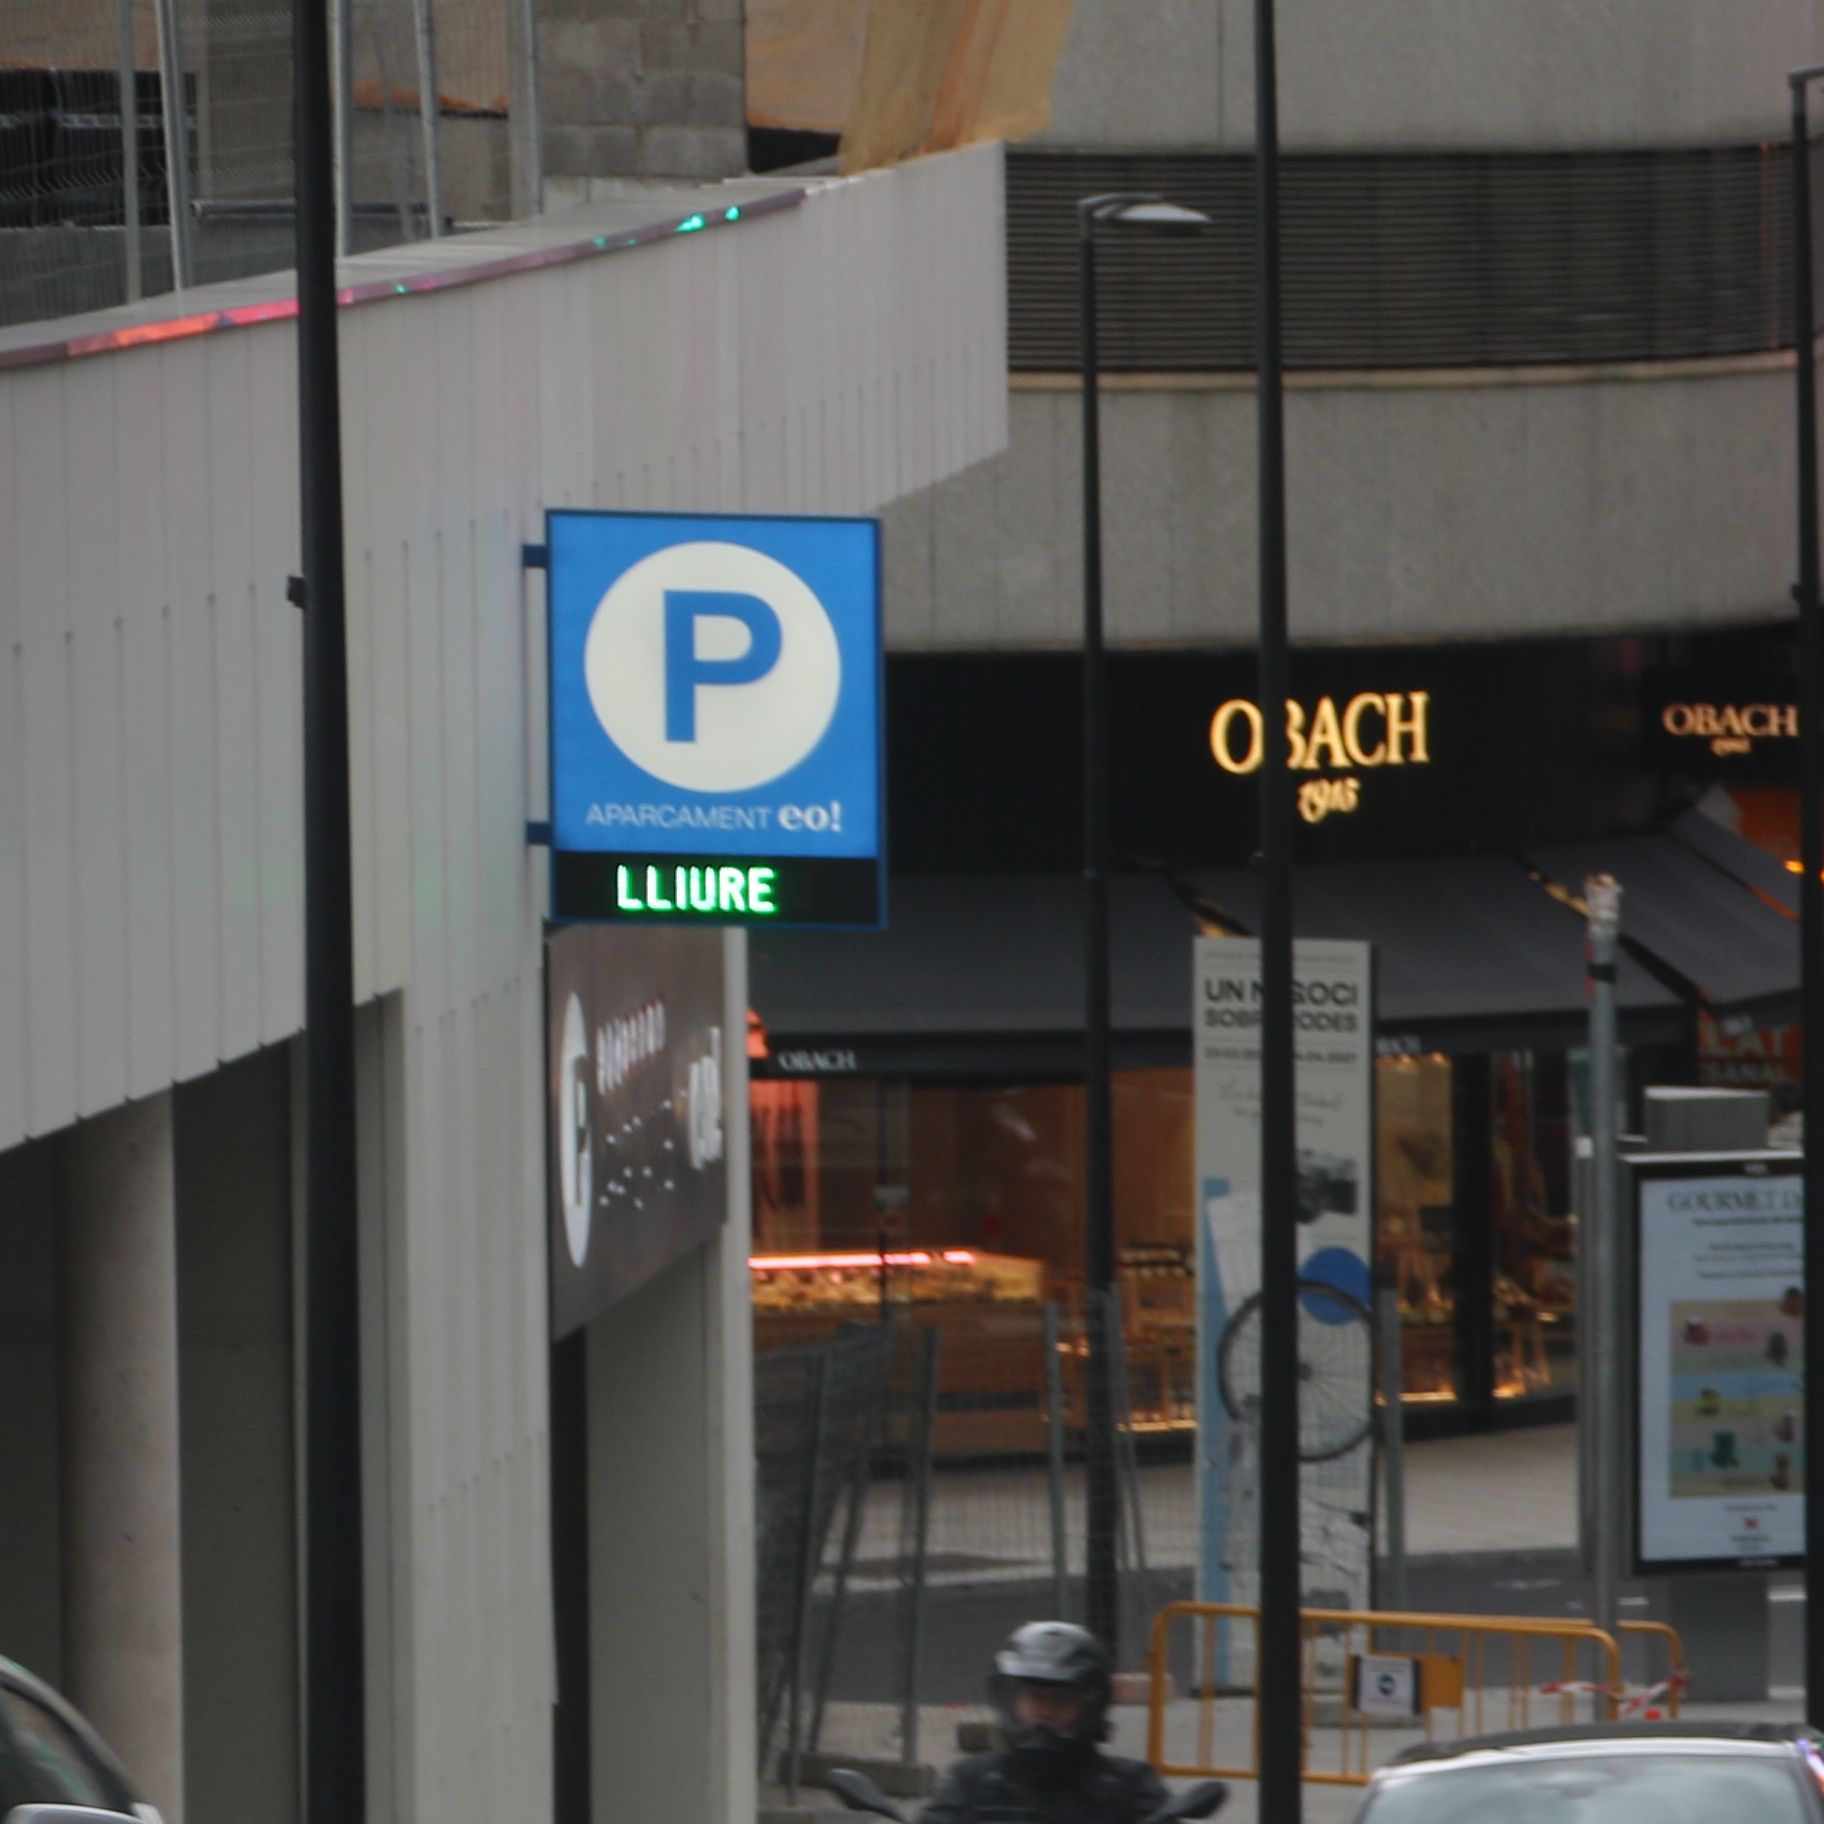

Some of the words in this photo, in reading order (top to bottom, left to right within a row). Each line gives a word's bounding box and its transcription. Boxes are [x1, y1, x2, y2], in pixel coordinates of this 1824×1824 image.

[662, 589, 783, 743] P
[1209, 691, 1430, 775] OBACH
[1662, 702, 1799, 736] OBACH
[586, 802, 772, 830] APARCAMENT
[777, 800, 843, 832] eo!
[616, 863, 777, 914] LLIURE
[1204, 977, 1244, 1003] UN
[1250, 979, 1358, 1007] NGOCI
[1204, 1008, 1262, 1028] SOBR
[1293, 1011, 1358, 1033] ODES
[779, 1049, 857, 1072] OBACH
